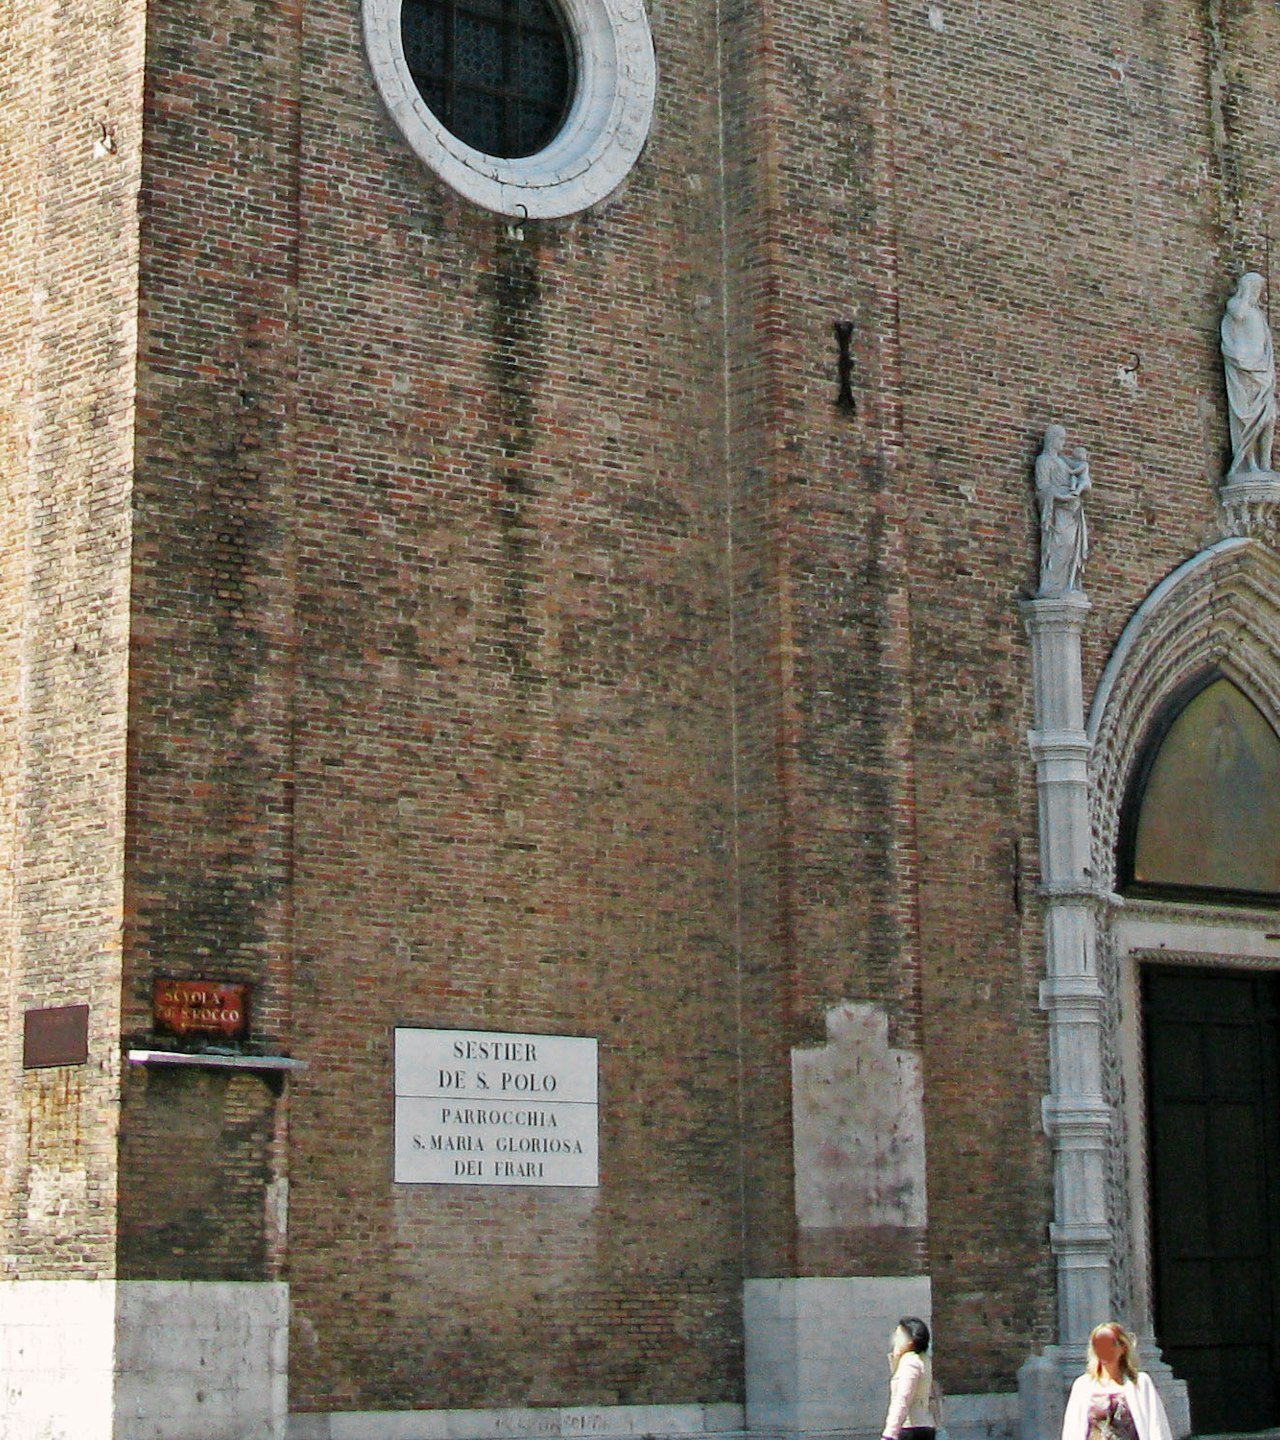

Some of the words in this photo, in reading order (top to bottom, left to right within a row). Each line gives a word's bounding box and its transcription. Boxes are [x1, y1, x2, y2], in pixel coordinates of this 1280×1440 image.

[453, 1040, 538, 1062] SESTIER
[438, 1069, 467, 1090] DE
[476, 1071, 490, 1091] S.
[501, 1072, 558, 1093] POLO
[441, 1108, 559, 1128] PARROCCHIA
[495, 1136, 584, 1154] GLORIOSA
[453, 1160, 483, 1177] DEI
[494, 1161, 545, 1178] FRARI
